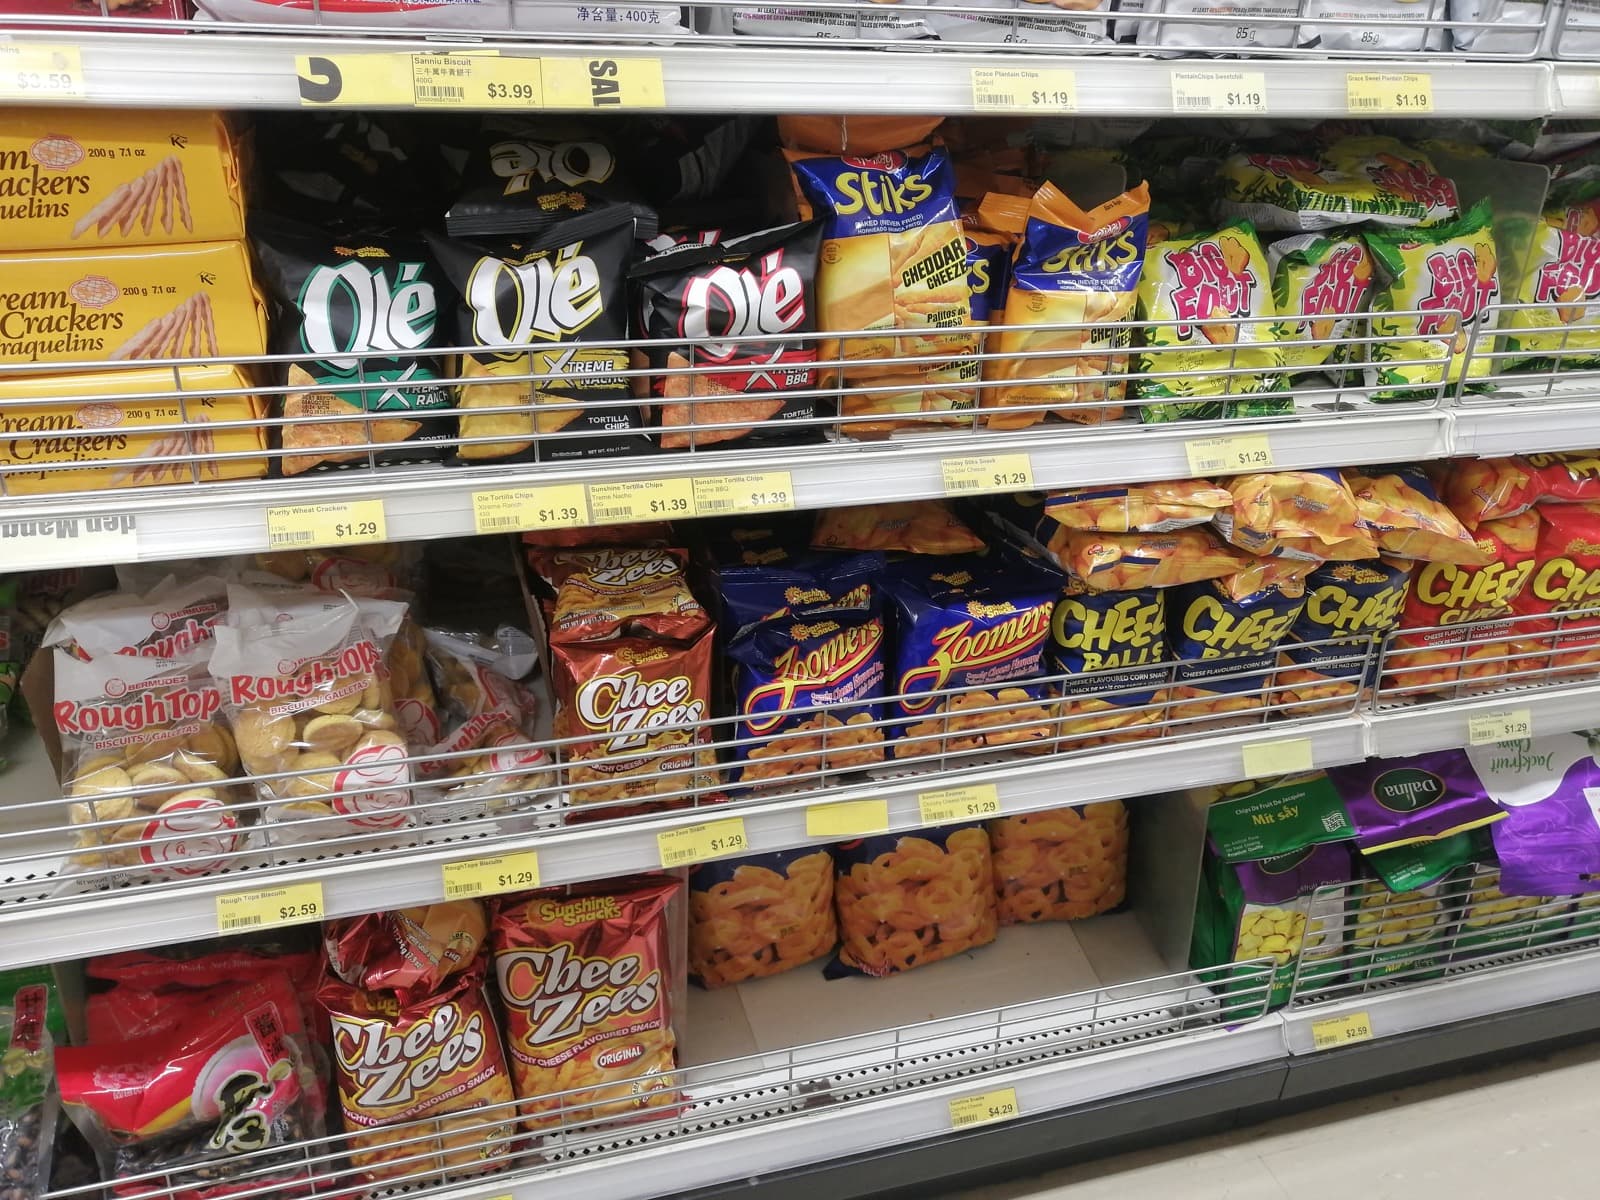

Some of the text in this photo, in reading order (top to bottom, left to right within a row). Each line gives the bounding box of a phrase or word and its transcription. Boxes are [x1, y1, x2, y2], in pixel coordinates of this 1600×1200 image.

[414, 57, 472, 67] Sanniu Biscuit
[17, 71, 72, 90] $3.59
[1021, 71, 1039, 79] Chips
[487, 82, 533, 99] $3.99
[1031, 90, 1068, 105] $1.19
[1227, 92, 1260, 106] $1.19
[1396, 94, 1427, 107] $1.19
[88, 147, 146, 159] 200 g 7.1 oz
[835, 171, 933, 216] Stiks
[1042, 230, 1140, 273] Stiks
[902, 238, 965, 288] CHEDDAR
[926, 259, 968, 290] CHEEZE
[123, 284, 177, 298] 200 g 7.1 oz
[466, 240, 604, 361] Olé
[677, 247, 806, 363] Olé
[0, 302, 124, 340] Crackers
[297, 258, 437, 375] Olé
[927, 309, 956, 324] Palitos
[785, 373, 808, 386] BBQ
[415, 390, 449, 406] RANCH
[126, 408, 179, 420] 200 g 7.1 oz
[587, 414, 630, 424] TORTILLA
[782, 408, 813, 420] TORTILLA
[604, 421, 630, 431] CHIPS
[1238, 450, 1267, 465] $1.29
[694, 478, 723, 486] Sunshine
[724, 476, 745, 484] Tortilla
[993, 472, 1026, 487] $1.29
[491, 494, 514, 502] Tortilla
[514, 492, 534, 500] Chips
[591, 485, 621, 493] Sunshine
[650, 498, 687, 513] $1.39
[751, 491, 787, 506] $1.39
[269, 504, 348, 518] Purity Wheat Crackers
[538, 507, 578, 522] $1.39
[335, 521, 377, 537] $1.29
[636, 651, 669, 665] Snacks
[1082, 640, 1163, 672] BALLS
[230, 640, 382, 704] RoughTop
[1182, 661, 1260, 679] CHEESE FLAVOURED CORN
[127, 675, 189, 693] BERMUDEZ
[269, 679, 370, 715] BISCUITS GALLETAS
[577, 671, 692, 728] Chee
[54, 686, 221, 734] RoughTop
[608, 699, 705, 752] Zees
[1504, 722, 1527, 735] $1.29
[94, 735, 144, 750] BISCUITS
[1491, 752, 1554, 775] Jackfruit
[1384, 778, 1438, 807] Dalina
[967, 801, 996, 815] $1.29
[711, 834, 743, 851] $1.29
[498, 871, 533, 887] $1.29
[220, 889, 287, 905] Rough Tops Biscuits
[280, 902, 317, 919] $2.59
[539, 896, 616, 921] Sunshine
[564, 907, 622, 926] Snacks
[496, 944, 640, 1006] Chee
[529, 971, 662, 1046] Zees
[330, 1003, 460, 1072] Chee
[1345, 1026, 1368, 1039] $2.59
[542, 1018, 662, 1067] CHEESE FLAVOURED SNACK
[356, 1014, 486, 1108] Zees
[599, 1046, 642, 1067] ORIGINAL
[406, 1065, 497, 1119] FLAVOURED SNACK
[988, 1103, 1013, 1118] $4.29
